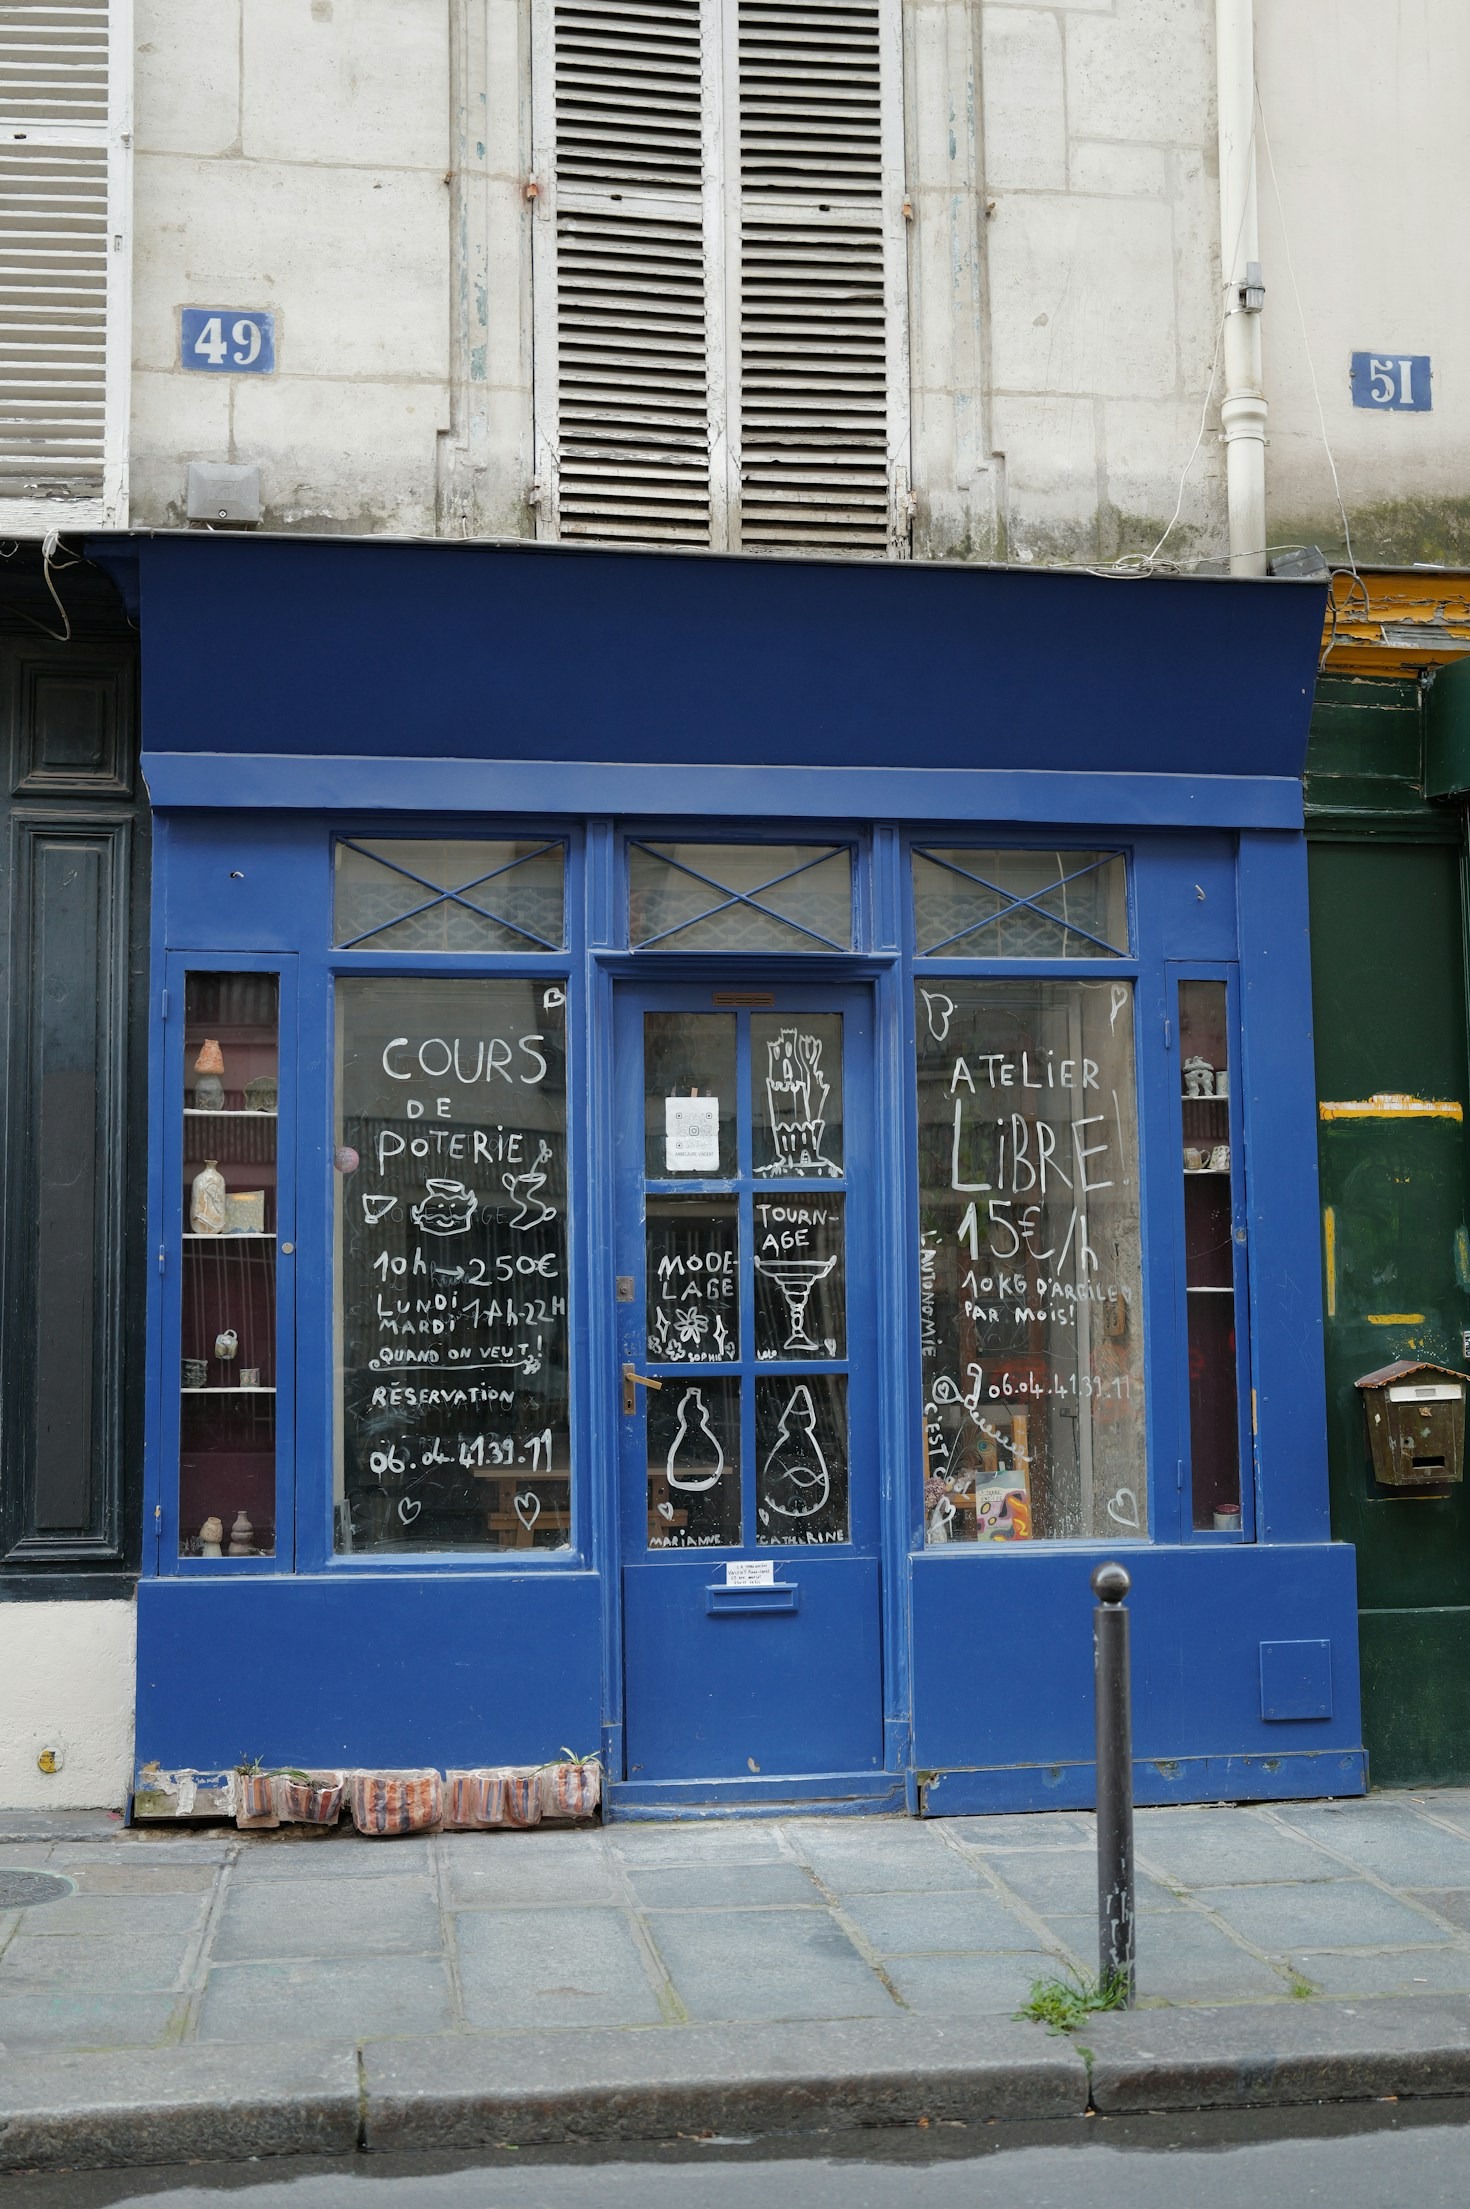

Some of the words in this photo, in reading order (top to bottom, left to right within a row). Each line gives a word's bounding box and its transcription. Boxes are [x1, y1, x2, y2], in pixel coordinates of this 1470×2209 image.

[194, 317, 262, 365] 49
[1370, 359, 1415, 404] 51
[382, 1034, 548, 1084] COURS
[406, 1097, 453, 1119] DE
[762, 1228, 810, 1258] AGE
[661, 1277, 735, 1301] LAGE
[964, 1300, 1000, 1323] PAR
[379, 1346, 440, 1366] QUAND
[448, 1345, 472, 1360] ON
[987, 1370, 1131, 1400] 06.04.41.39.11
